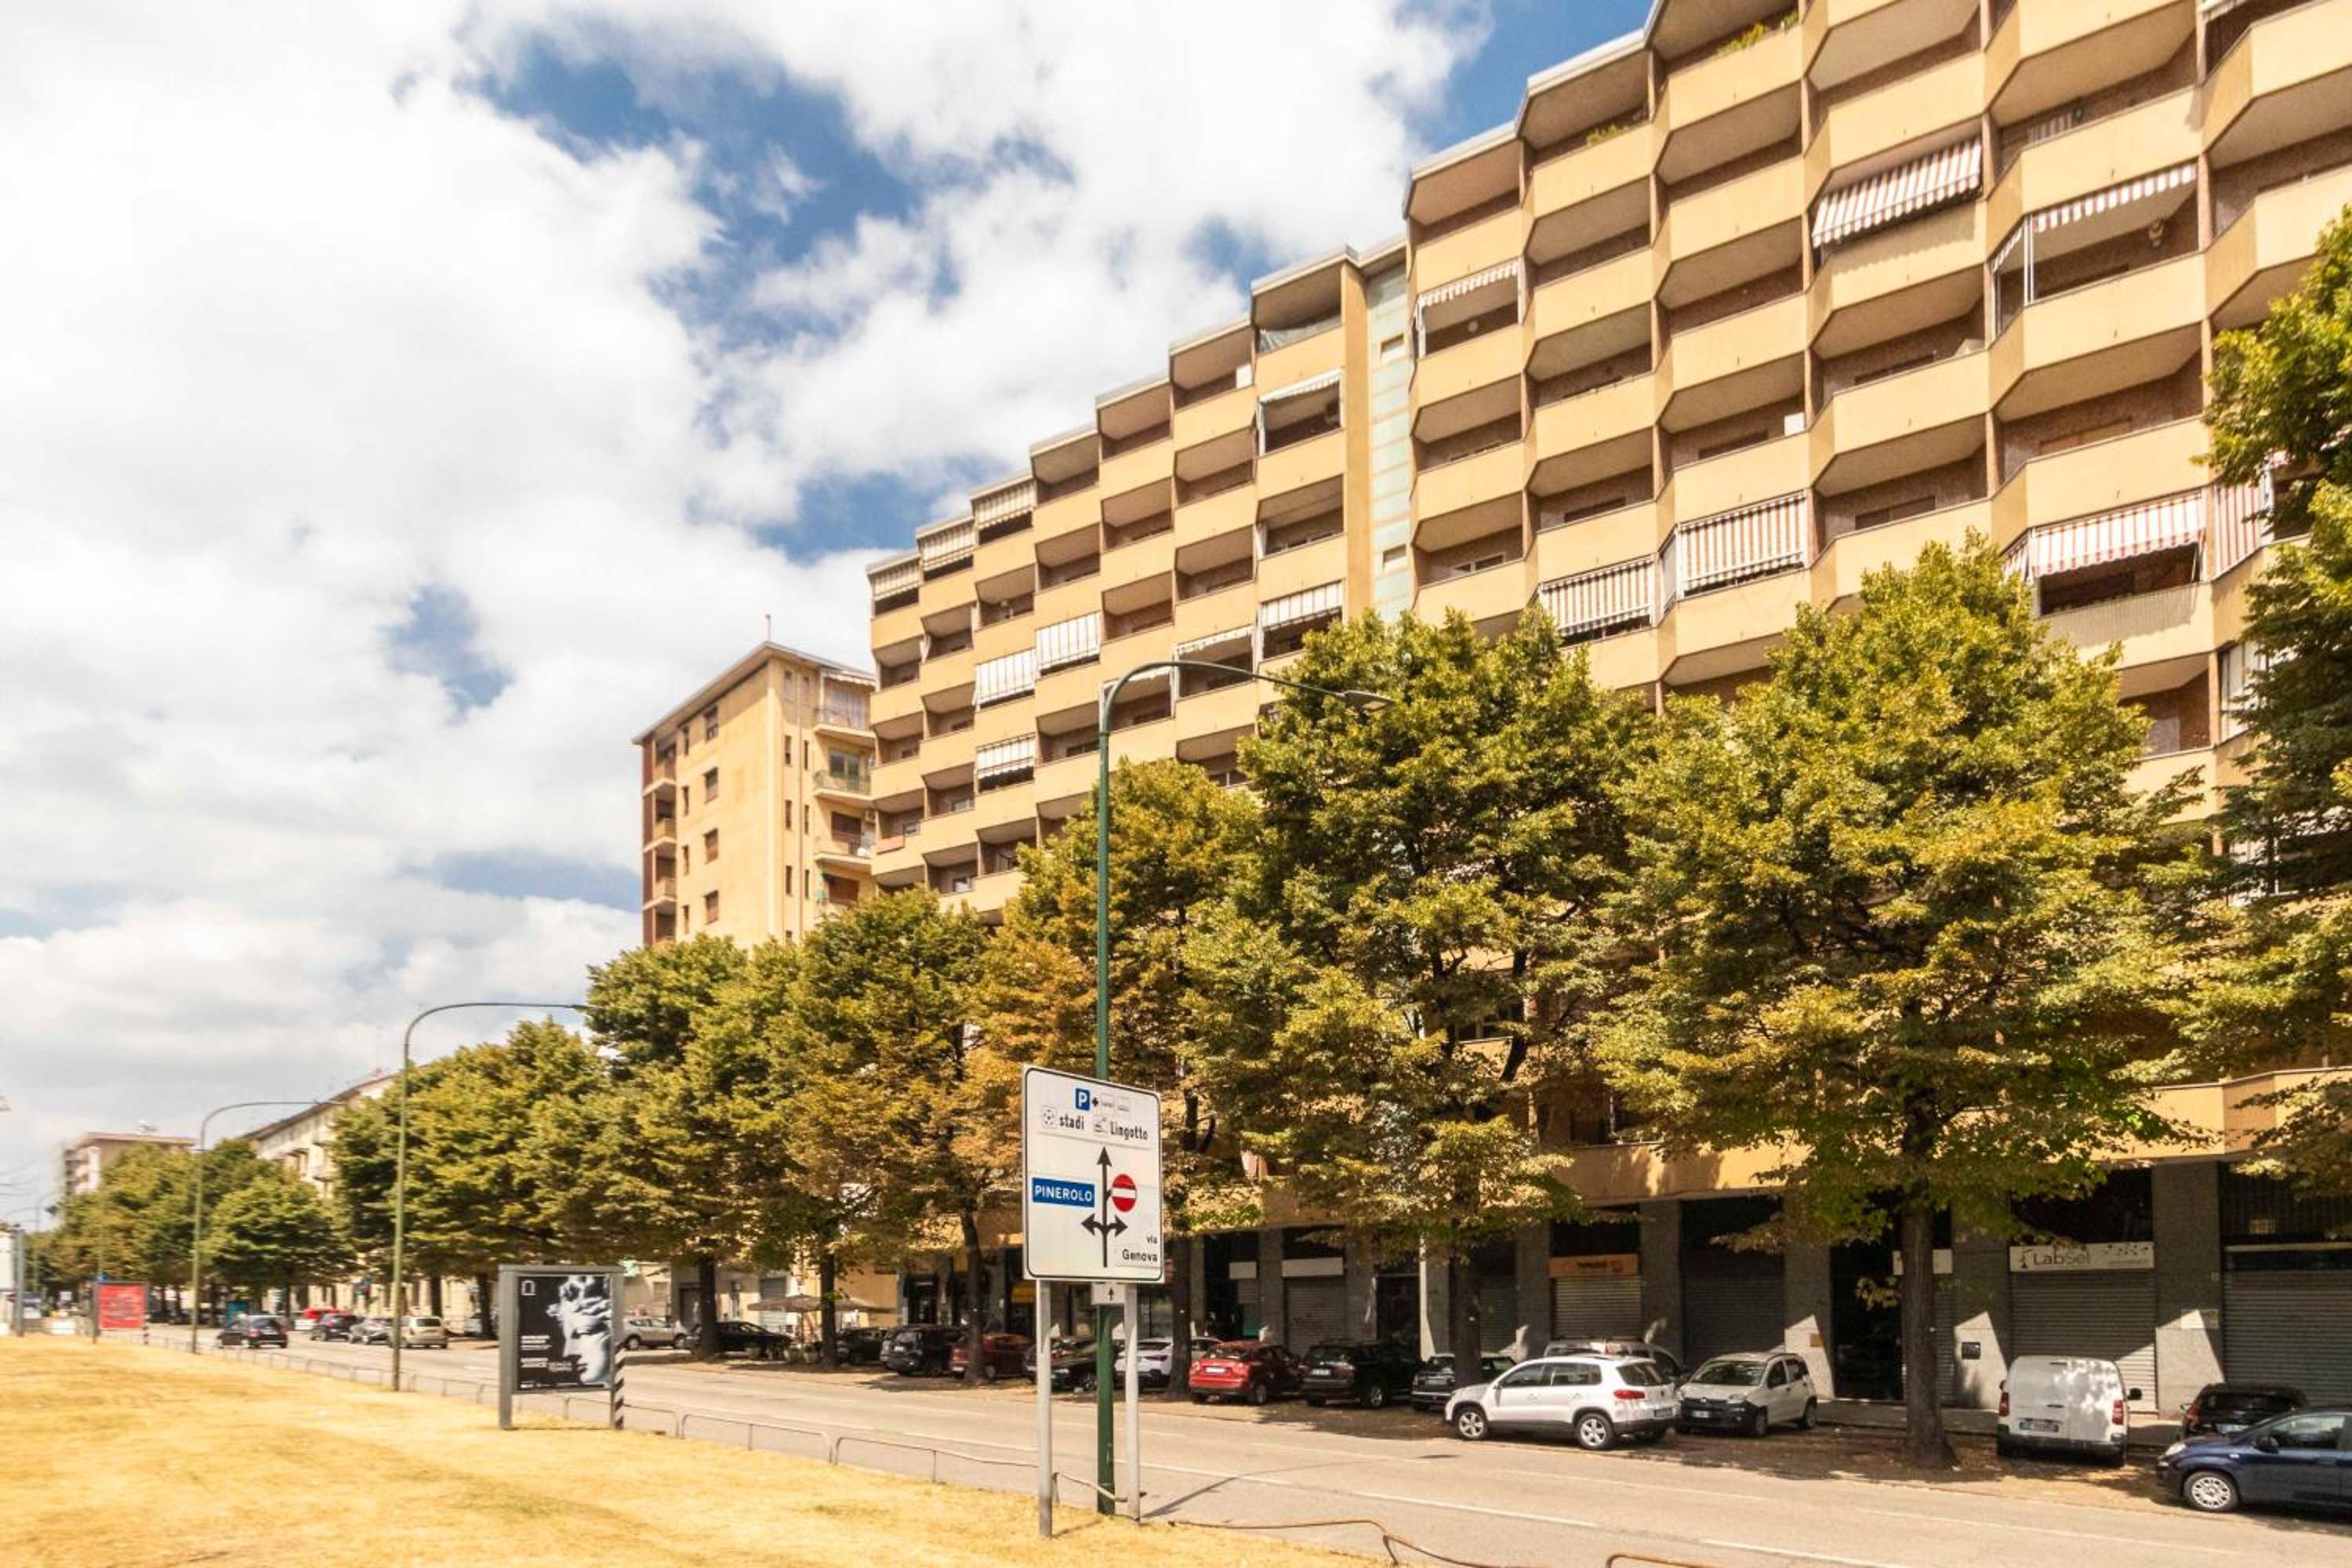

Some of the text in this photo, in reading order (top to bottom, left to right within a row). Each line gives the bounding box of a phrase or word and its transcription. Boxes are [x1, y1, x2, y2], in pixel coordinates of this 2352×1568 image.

[1078, 1091, 1087, 1108] P
[1059, 1114, 1084, 1130] stadi
[1110, 1121, 1149, 1140] Lingotto
[1034, 1185, 1092, 1202] PINEROLO
[1145, 1234, 1158, 1244] via
[1122, 1248, 1158, 1261] Genova
